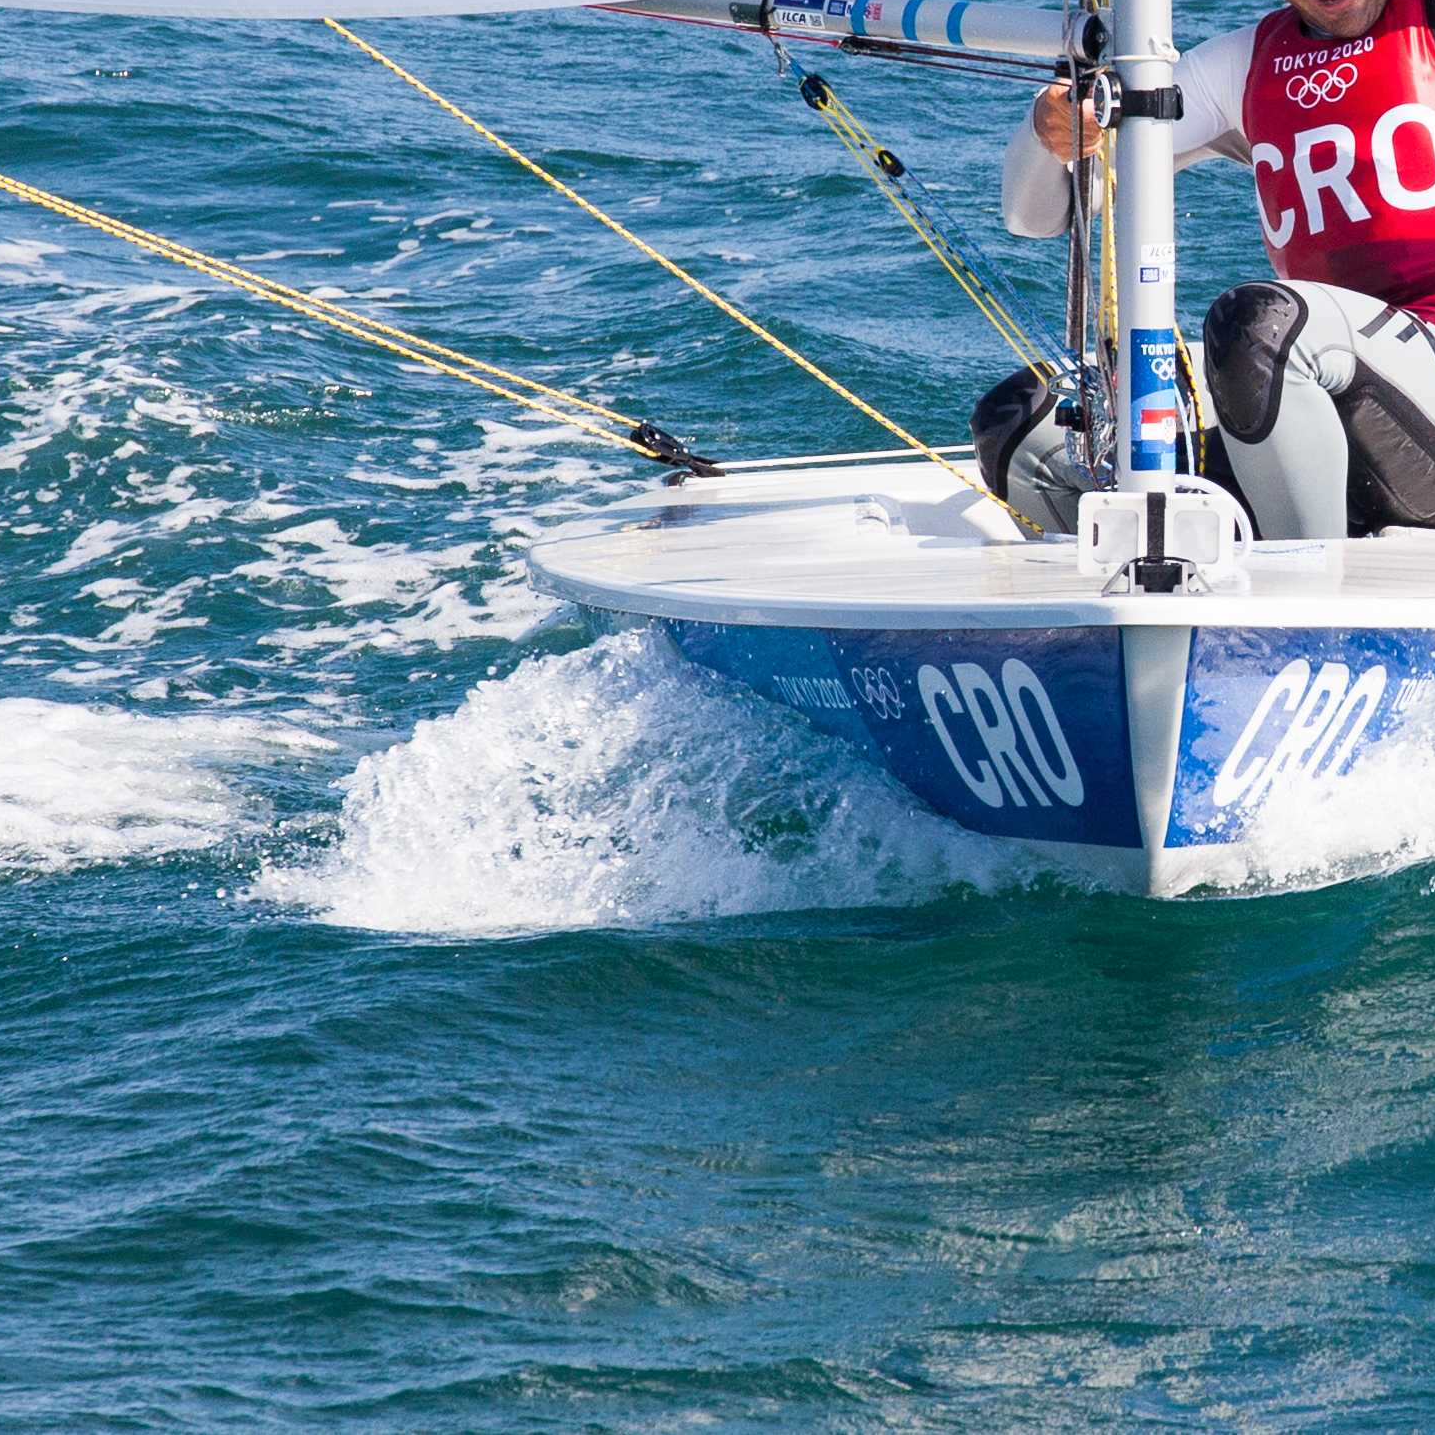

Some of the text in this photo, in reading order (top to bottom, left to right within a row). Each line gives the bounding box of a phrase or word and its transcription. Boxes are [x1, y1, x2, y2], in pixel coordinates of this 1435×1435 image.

[782, 12, 806, 24] ILCA
[1273, 36, 1375, 74] TOKYO 2020
[772, 675, 852, 709] TOKYO 2020
[917, 658, 1085, 808] CRO
